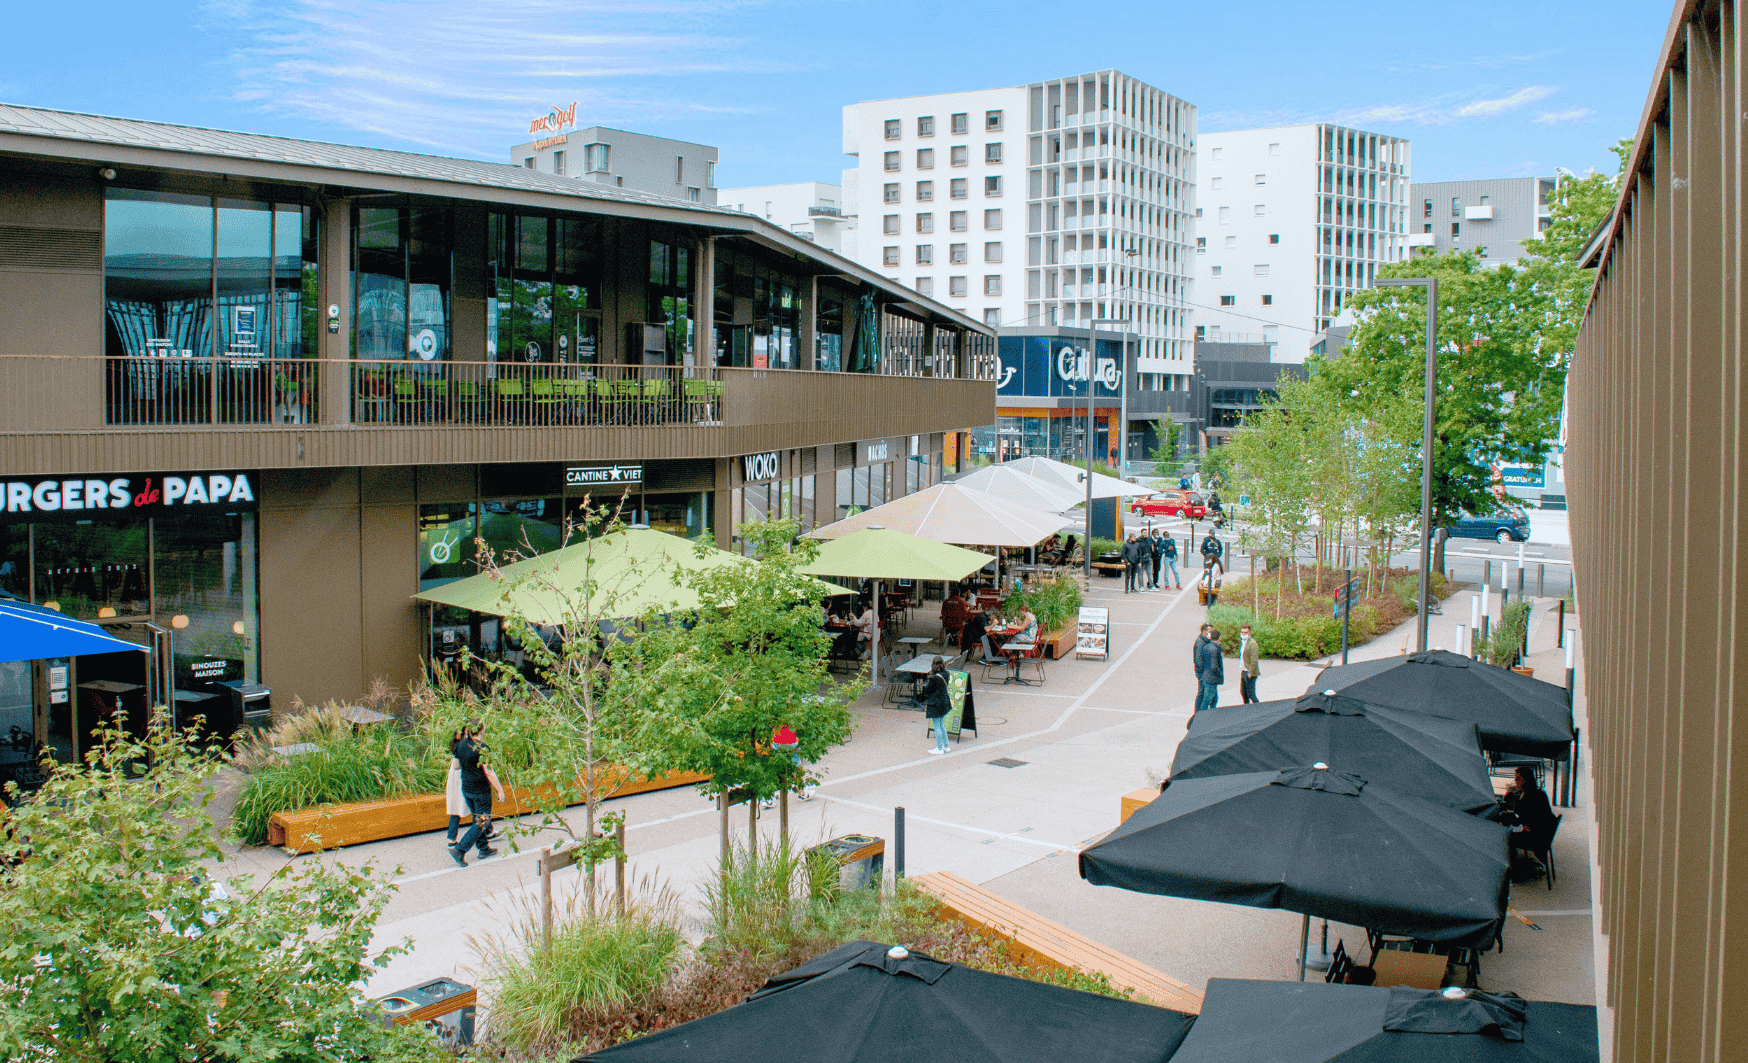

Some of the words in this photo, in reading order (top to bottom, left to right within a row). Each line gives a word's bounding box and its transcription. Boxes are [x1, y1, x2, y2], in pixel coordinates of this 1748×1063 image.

[745, 453, 778, 481] WOKO
[566, 471, 608, 482] CANTINE
[623, 469, 642, 480] VIET
[135, 478, 160, 506] de
[163, 475, 254, 506] PAPA
[47, 566, 96, 575] DEPUIS
[191, 661, 227, 670] BINOUZES
[194, 669, 224, 678] MAISON
